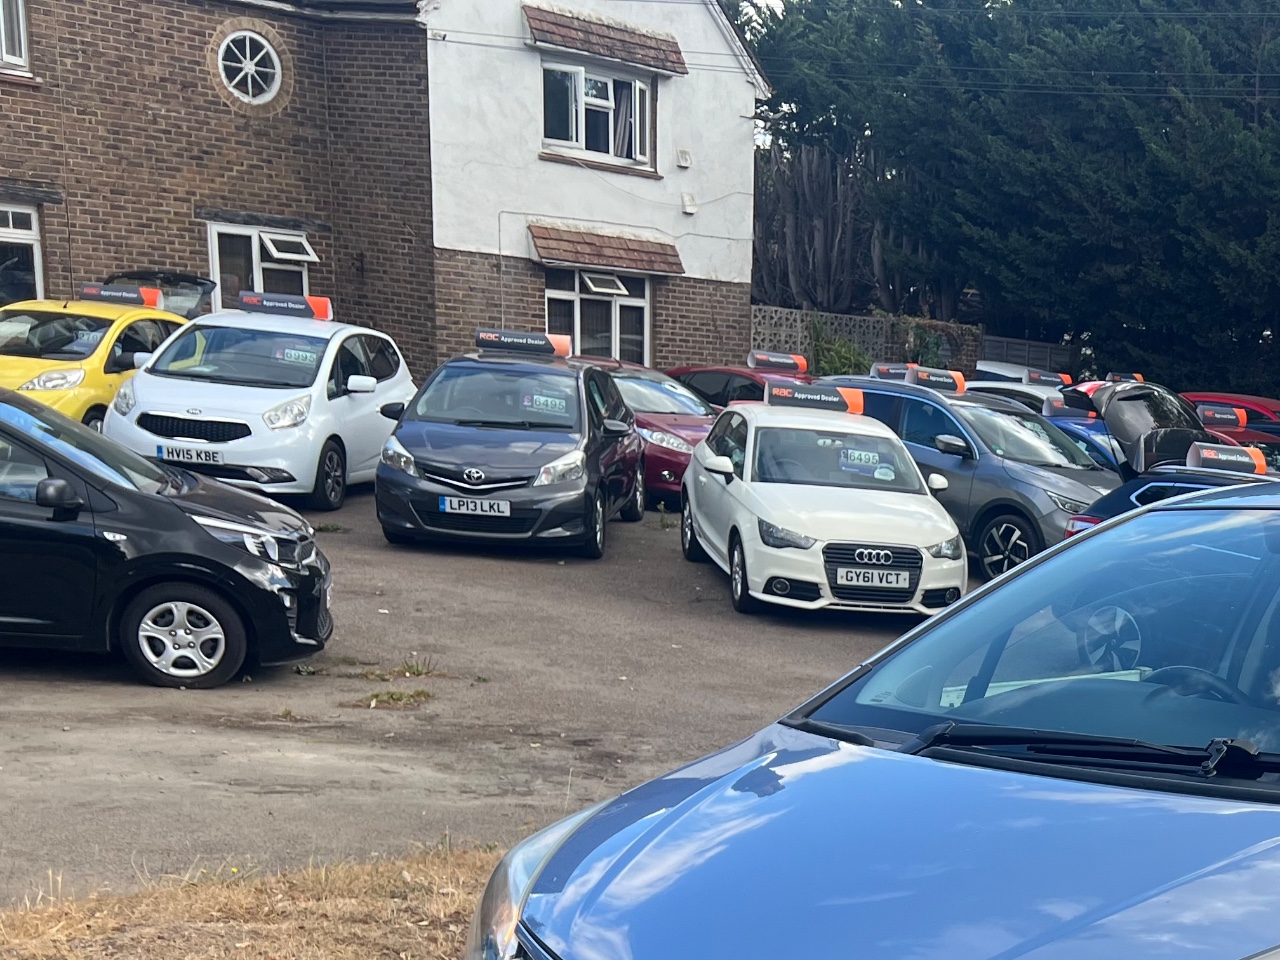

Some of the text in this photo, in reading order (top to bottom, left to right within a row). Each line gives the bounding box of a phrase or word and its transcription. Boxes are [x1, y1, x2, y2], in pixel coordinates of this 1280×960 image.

[167, 447, 219, 462] HV15 KBE
[450, 498, 505, 514] LP13 LKL
[845, 570, 902, 585] GY61 VCT
